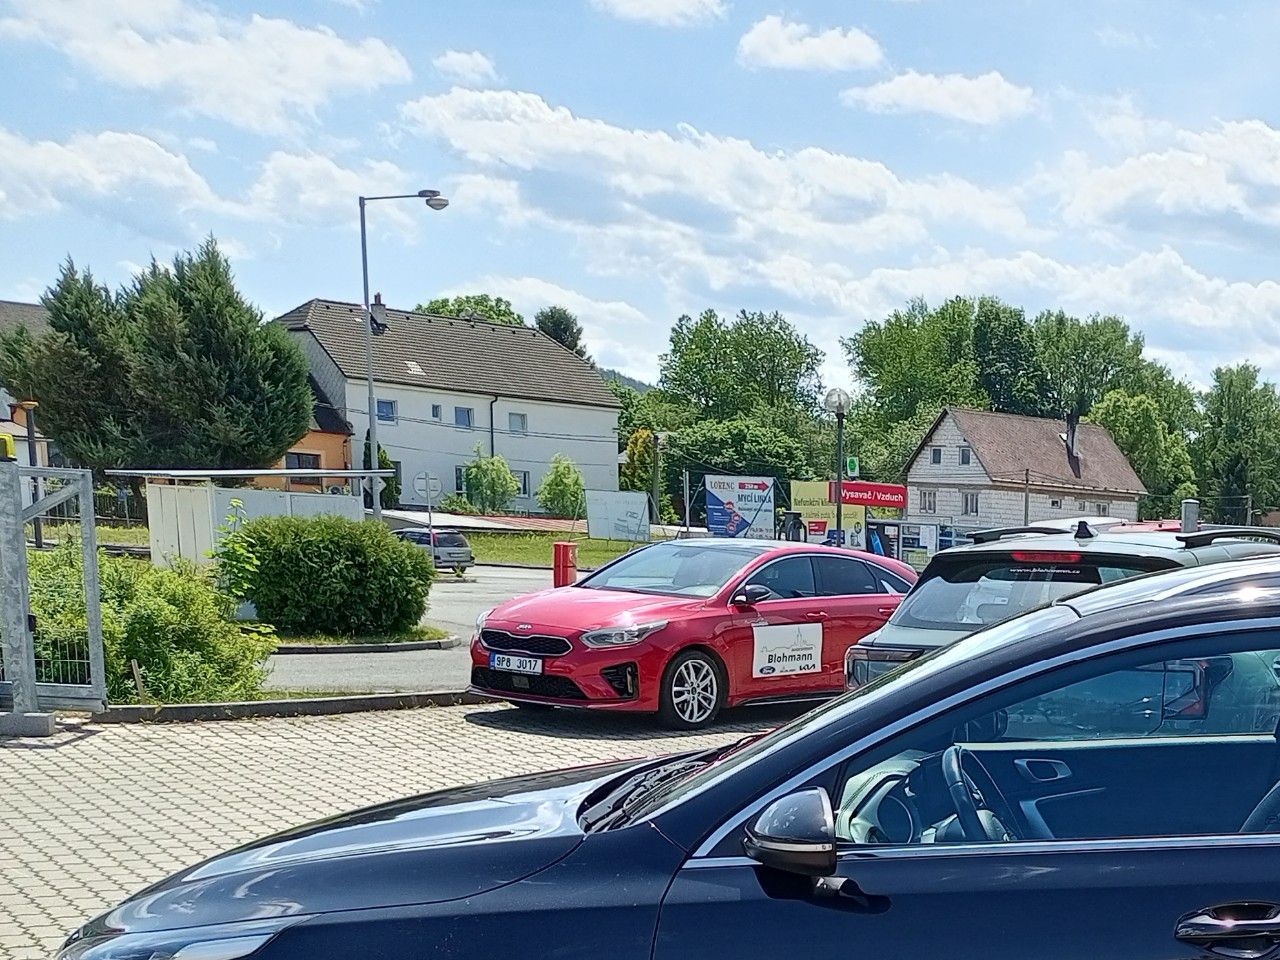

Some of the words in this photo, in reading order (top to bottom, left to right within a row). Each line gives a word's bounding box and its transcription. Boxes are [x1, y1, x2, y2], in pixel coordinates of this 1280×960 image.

[840, 488, 872, 501] Vysavač
[877, 492, 903, 503] Vzduch
[496, 656, 511, 668] 9P8
[516, 658, 538, 671] 3017
[768, 652, 813, 664] Blohmann
